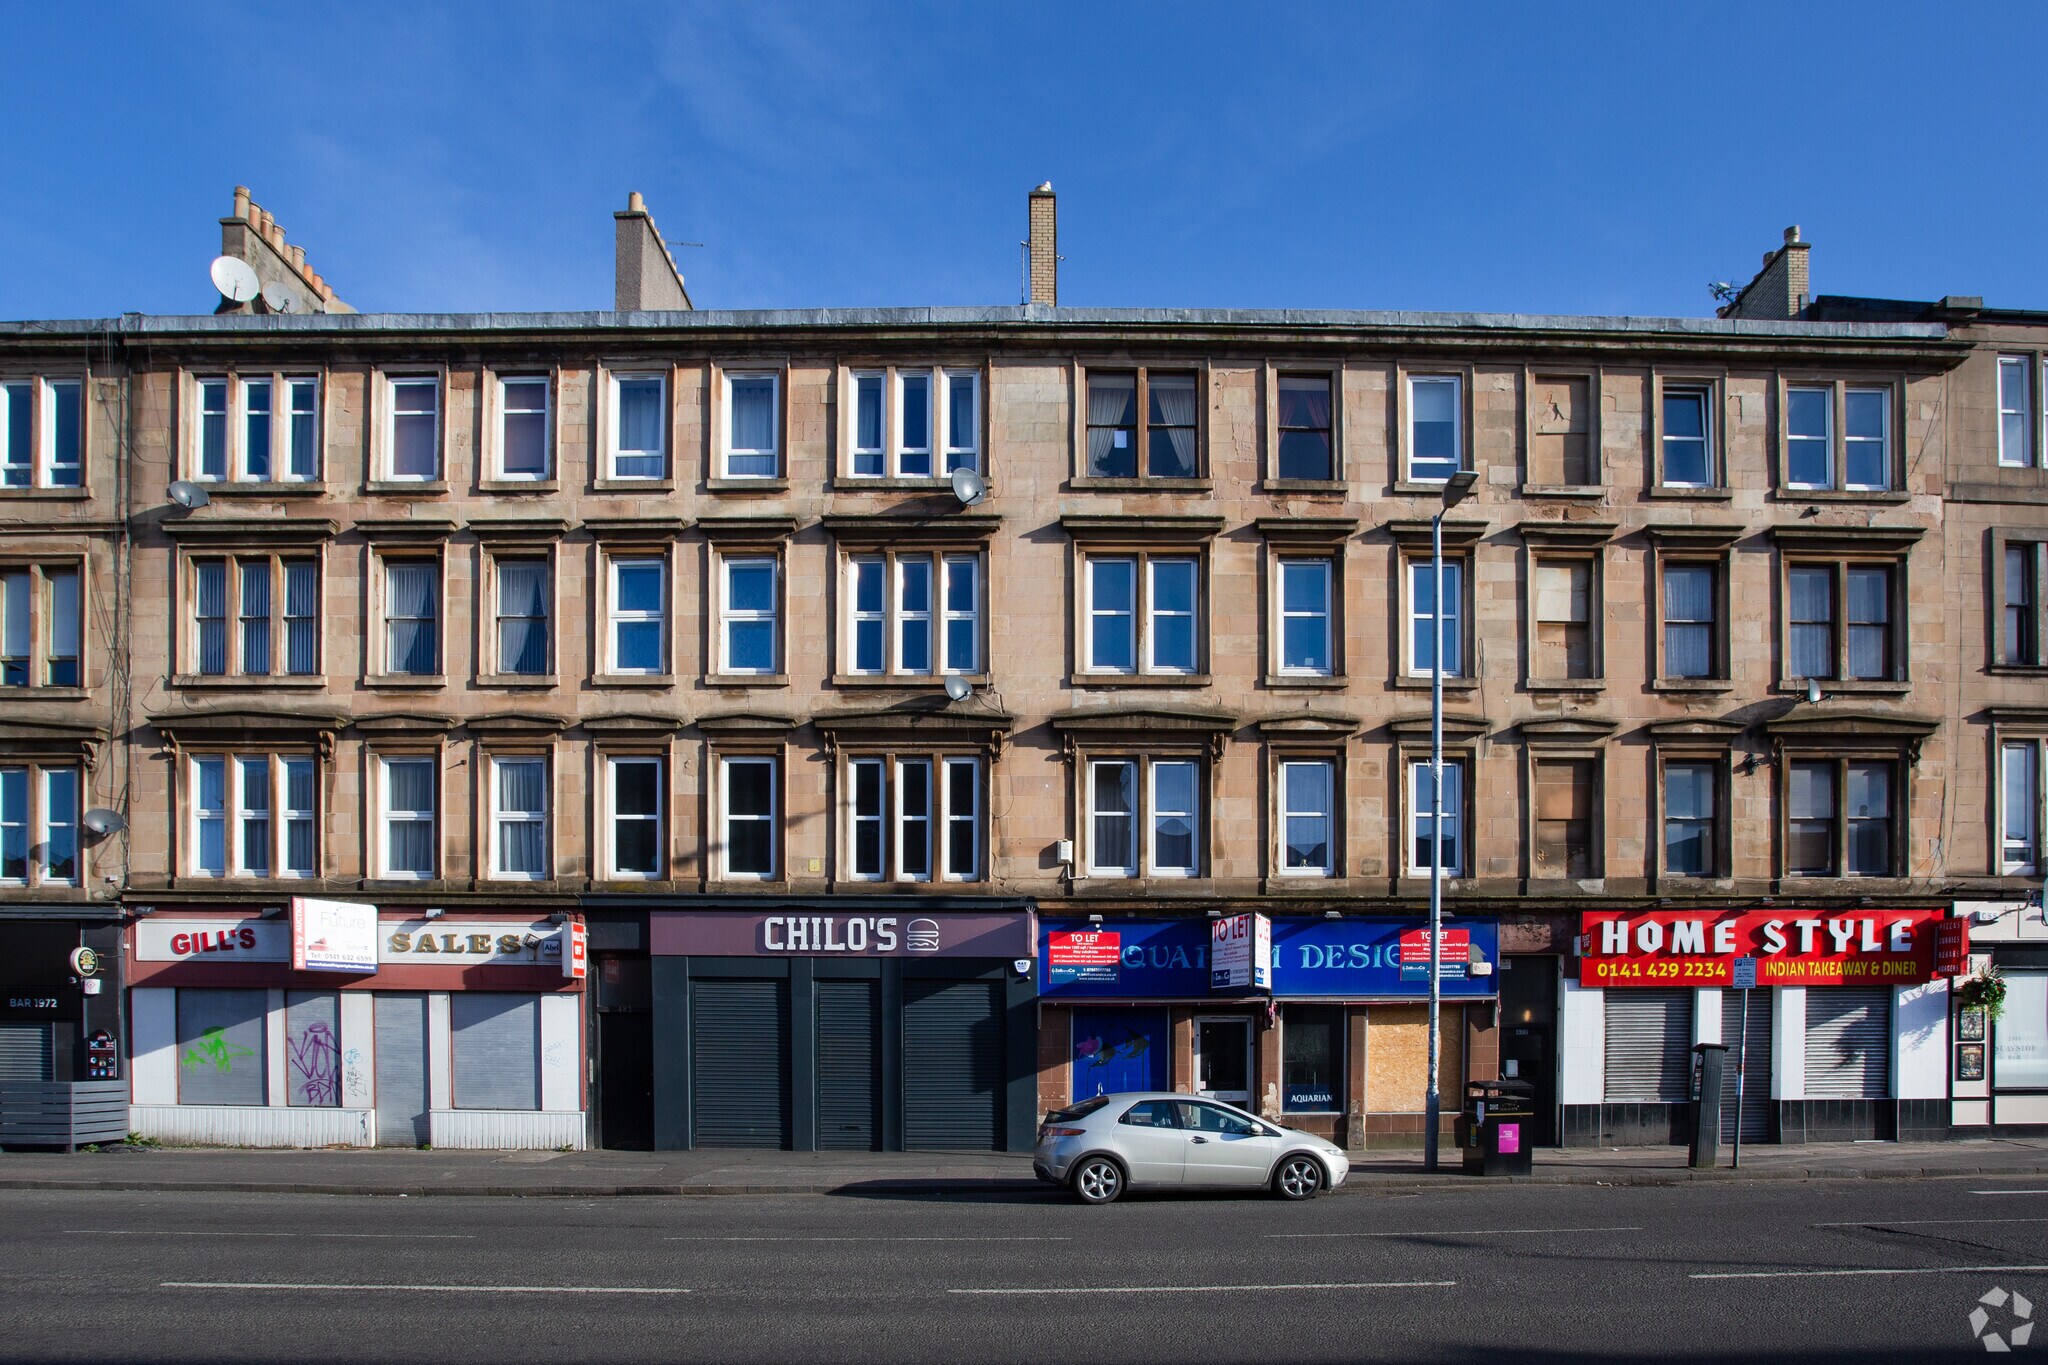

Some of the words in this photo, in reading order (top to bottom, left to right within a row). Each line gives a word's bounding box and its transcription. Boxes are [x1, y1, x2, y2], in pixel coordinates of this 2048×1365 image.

[320, 911, 366, 930] Future
[1212, 919, 1228, 943] TO
[1232, 915, 1250, 939] LET
[1939, 922, 1960, 930] PIZZAS
[171, 928, 256, 955] GILL'S
[389, 932, 521, 954] SALES
[765, 917, 897, 951] CHILO'S
[1071, 934, 1083, 942] TO
[1085, 934, 1099, 942] LET
[1602, 920, 1737, 954] HOME
[1762, 919, 1913, 953] STYLE
[1298, 944, 1400, 968] DESIG
[1597, 963, 1642, 977] 0141
[1646, 963, 1679, 978] 429
[1684, 963, 1727, 978] 2234
[1766, 962, 1805, 976] INDIAN
[1808, 962, 1868, 976] TAKEAWAY
[1871, 962, 1880, 976] &
[1882, 961, 1917, 976] DINER
[10, 999, 31, 1007] BAR
[34, 998, 58, 1008] 1972
[1290, 1094, 1333, 1103] AQUARIAN
